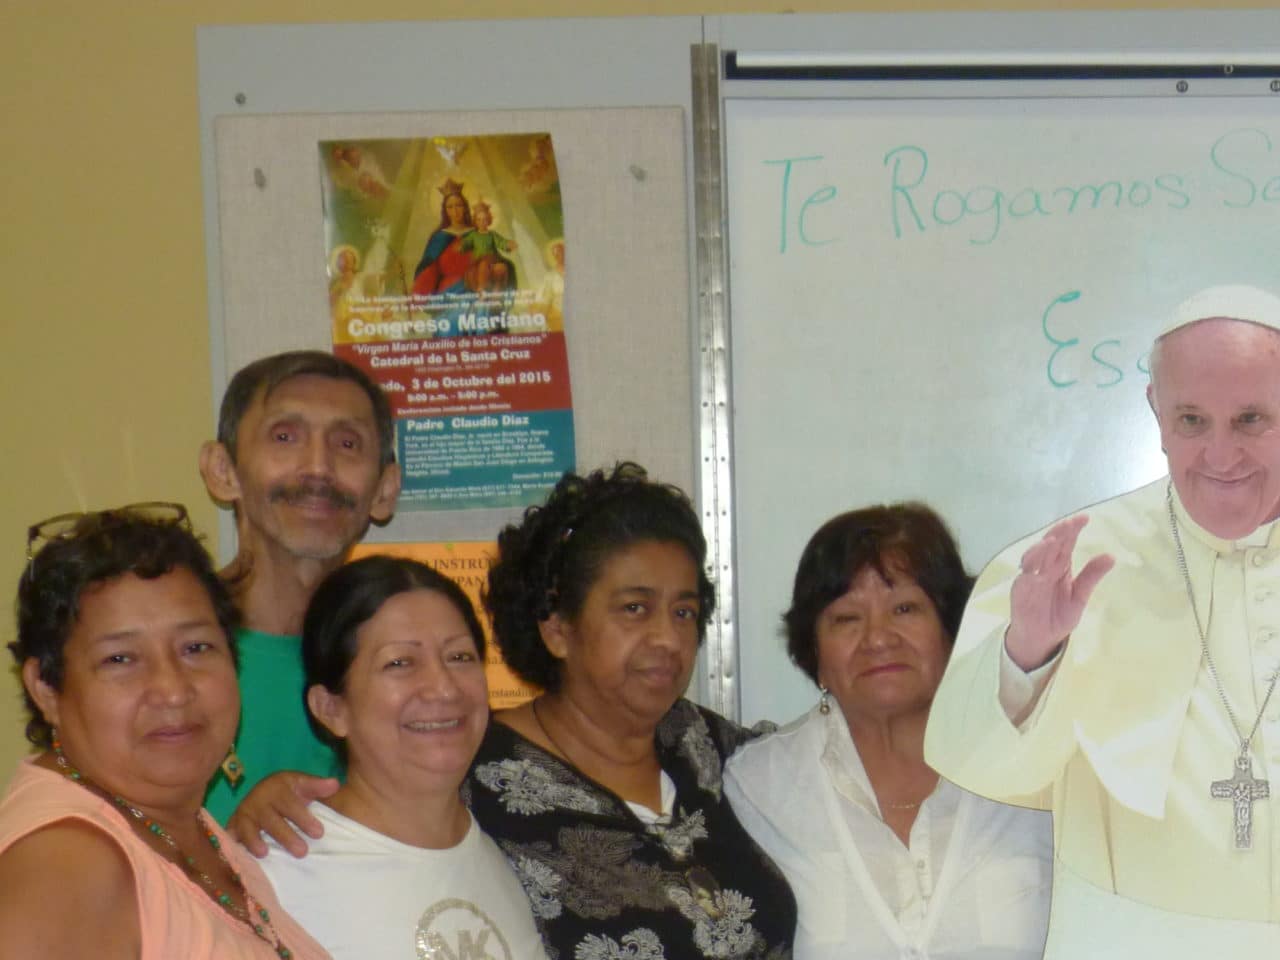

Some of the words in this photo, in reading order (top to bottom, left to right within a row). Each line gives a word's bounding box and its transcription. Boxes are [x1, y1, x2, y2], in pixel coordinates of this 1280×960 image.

[761, 155, 842, 254] Te
[884, 145, 1190, 245] Rogamos
[348, 317, 449, 338] Congreso
[458, 311, 546, 331] Mariano
[458, 336, 470, 348] de
[473, 335, 488, 347] los
[371, 352, 424, 368] Catedral
[427, 351, 443, 364] de
[446, 350, 457, 363] la
[460, 348, 497, 362] Santa
[501, 346, 530, 360] Cruz
[424, 377, 438, 389] de
[442, 374, 492, 388] Octubre
[497, 373, 515, 385] del
[519, 371, 551, 383] 2015
[407, 419, 444, 431] Padre
[452, 416, 498, 429] Claudio
